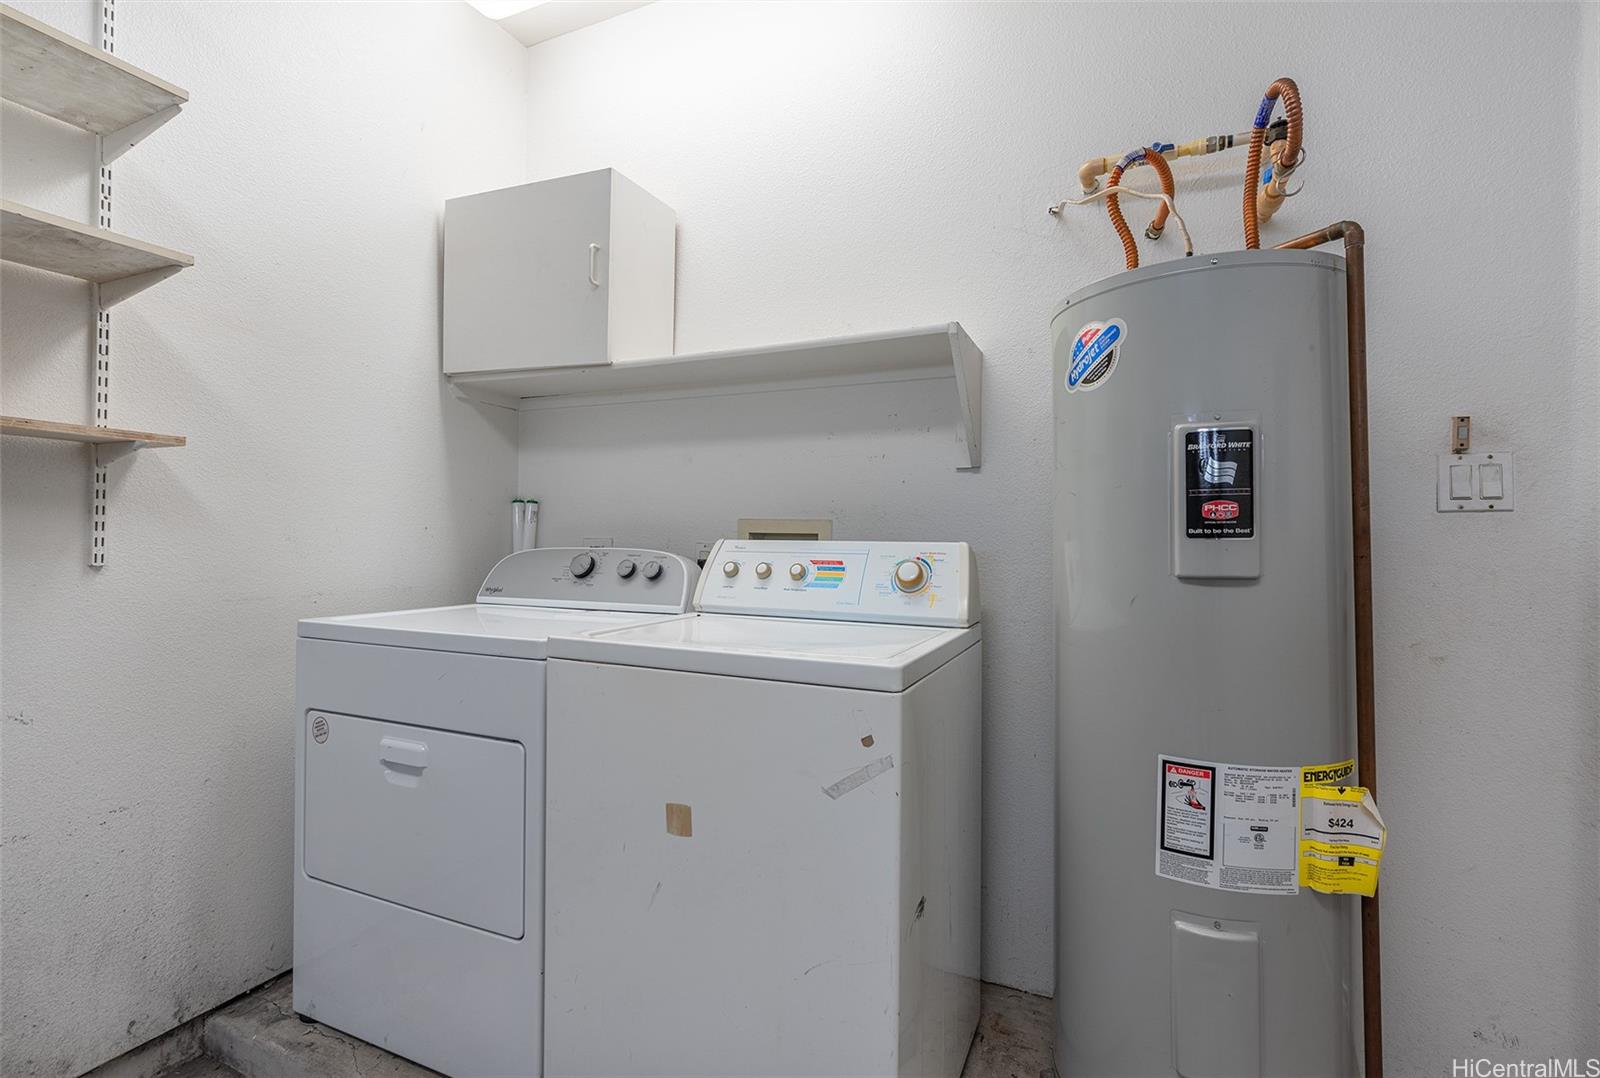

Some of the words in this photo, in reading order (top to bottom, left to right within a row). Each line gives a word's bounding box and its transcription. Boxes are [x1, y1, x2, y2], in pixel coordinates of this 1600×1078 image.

[1187, 442, 1227, 450] BRAFORD
[1178, 767, 1205, 777] DANGER
[1328, 817, 1354, 829] $424
